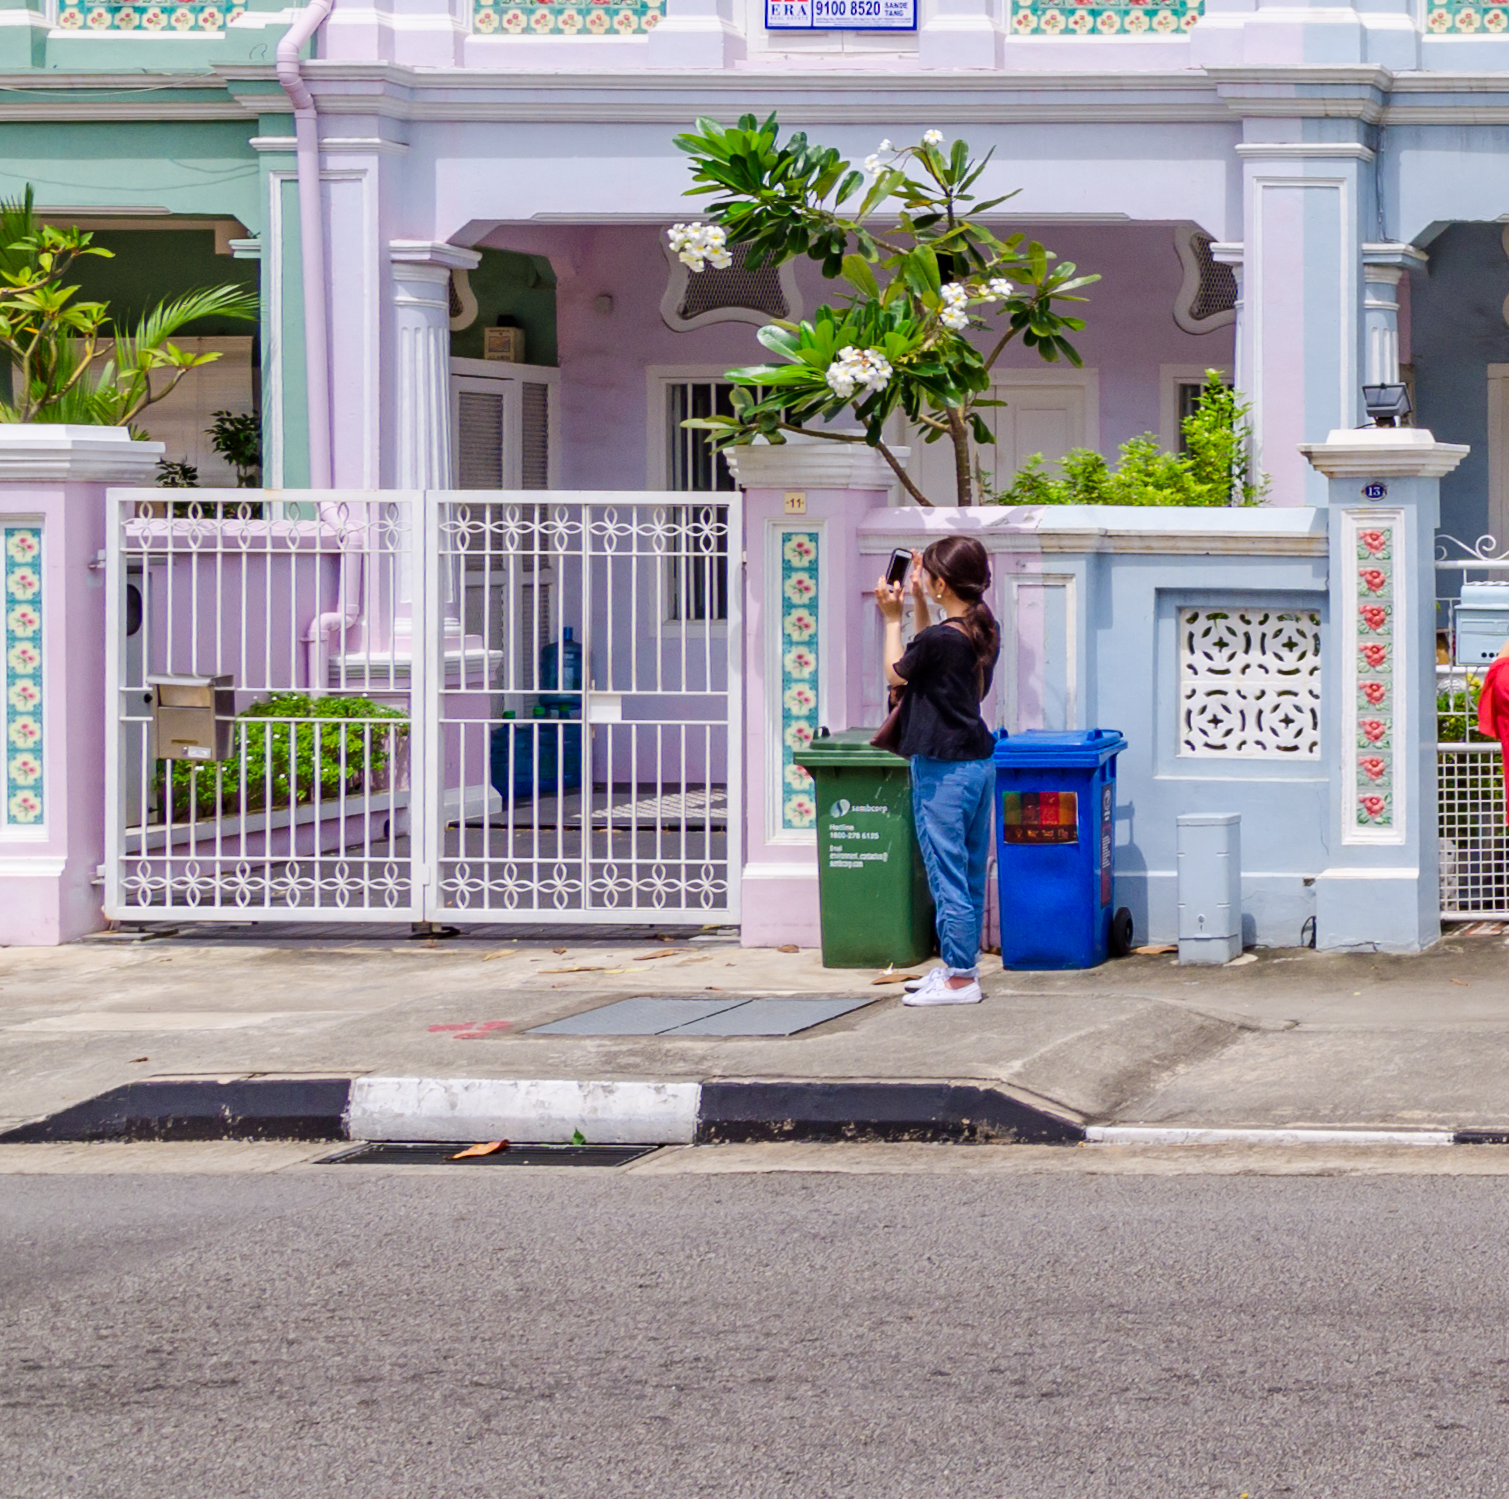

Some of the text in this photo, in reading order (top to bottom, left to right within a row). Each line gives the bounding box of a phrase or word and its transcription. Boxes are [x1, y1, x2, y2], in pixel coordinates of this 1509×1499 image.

[771, 4, 807, 16] ERA
[815, 1, 881, 16] 9100 8520
[1368, 486, 1381, 496] 13
[790, 497, 802, 508] 11
[852, 803, 889, 814] sembcorp
